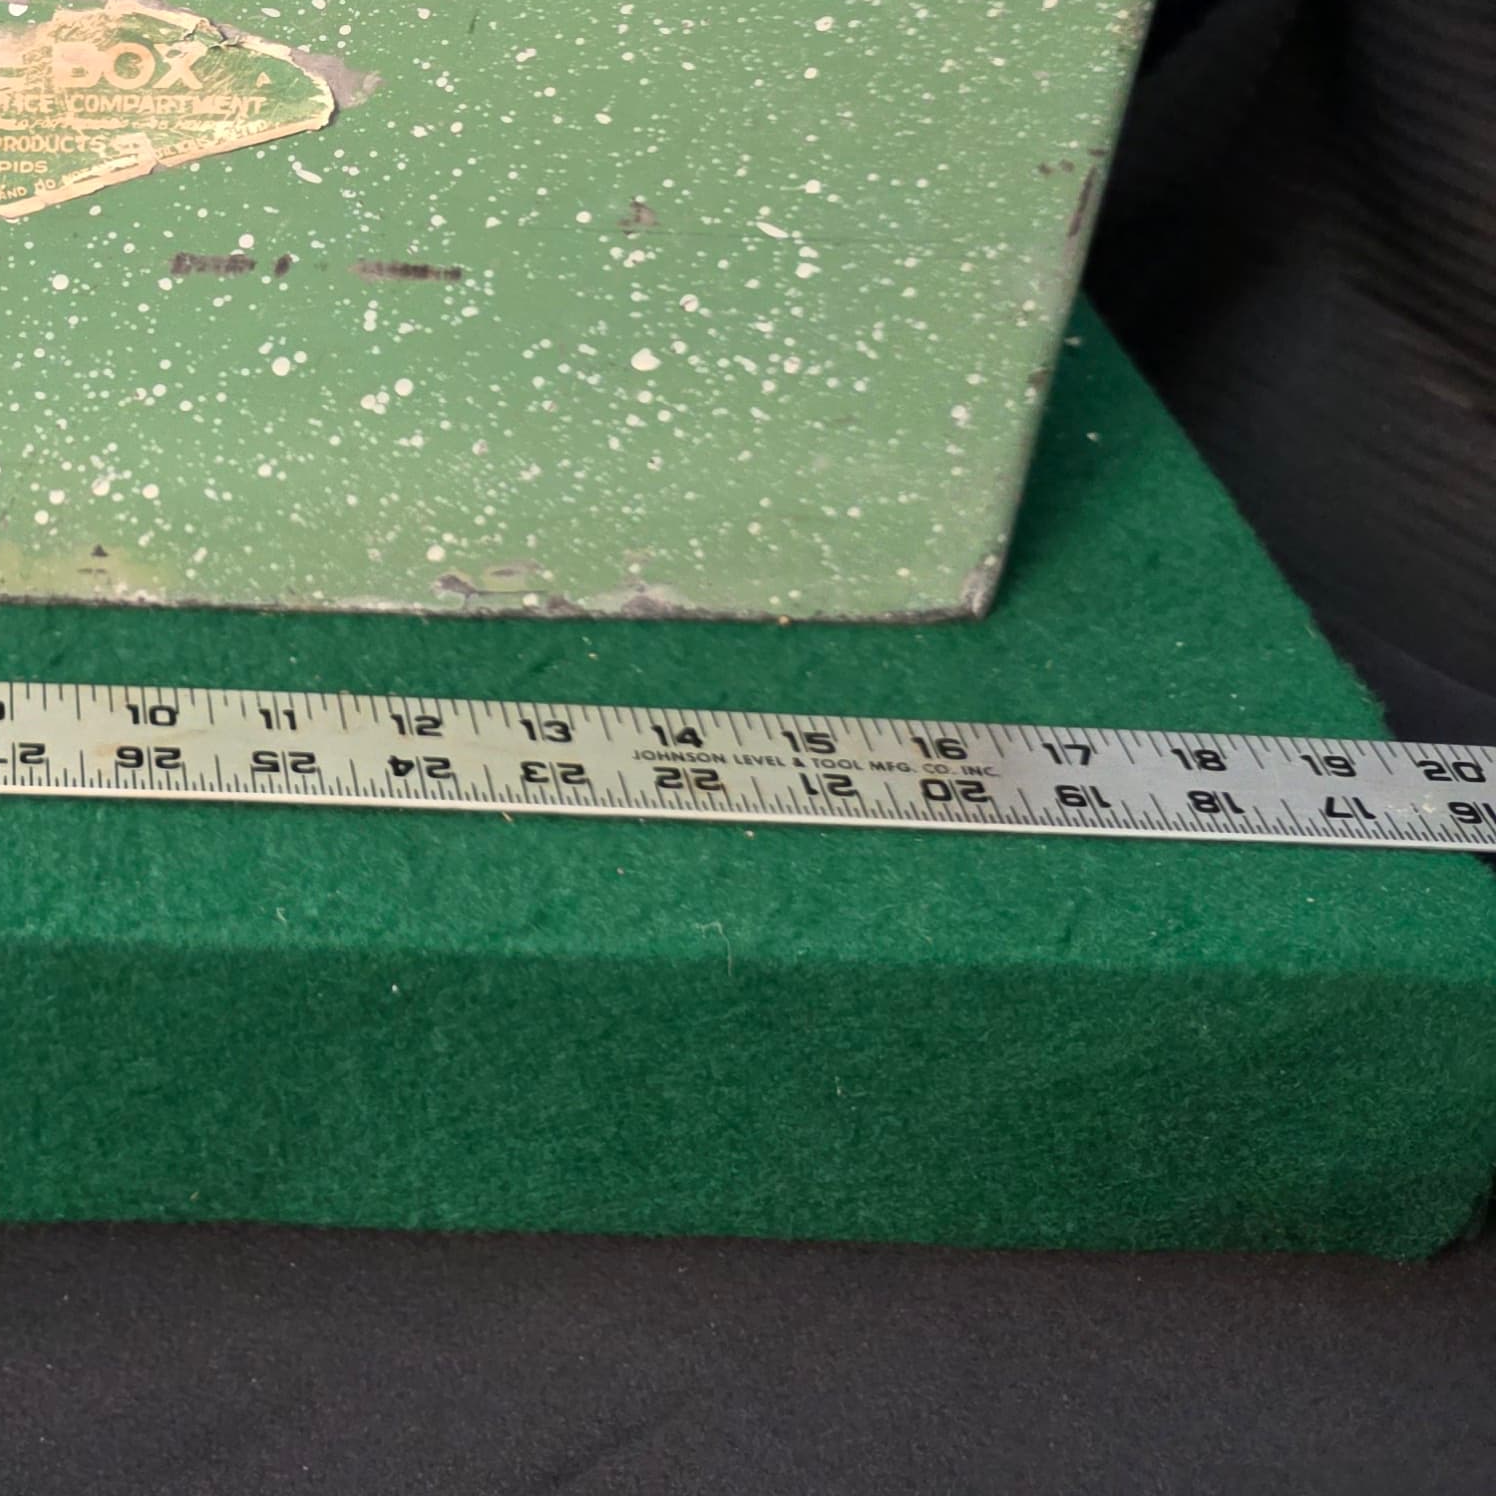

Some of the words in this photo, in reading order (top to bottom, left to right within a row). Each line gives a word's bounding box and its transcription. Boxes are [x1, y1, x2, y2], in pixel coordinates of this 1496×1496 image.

[66, 94, 267, 116] COMPARTMENT
[126, 704, 178, 727] 10
[259, 708, 296, 731] 11
[390, 713, 443, 737] 12
[519, 718, 573, 743] 13
[651, 724, 704, 749] 14
[781, 730, 837, 754] 15
[911, 735, 968, 761] 16
[1041, 742, 1092, 766] 17
[1171, 748, 1228, 772] 18
[1301, 754, 1357, 777] 19
[1416, 760, 1486, 783] 20
[117, 745, 182, 770] 26
[253, 751, 317, 775] 25
[389, 755, 452, 780] 24
[632, 749, 728, 765] JOHNSON
[732, 754, 786, 768] LEVEL
[791, 756, 807, 768] &
[811, 757, 864, 771] TOOL
[521, 761, 585, 786] 23
[652, 766, 722, 792] 22
[799, 772, 857, 797] 21
[920, 778, 990, 803] 20
[1055, 784, 1112, 808] 19
[1187, 789, 1245, 815] 18
[1325, 796, 1377, 821] 17
